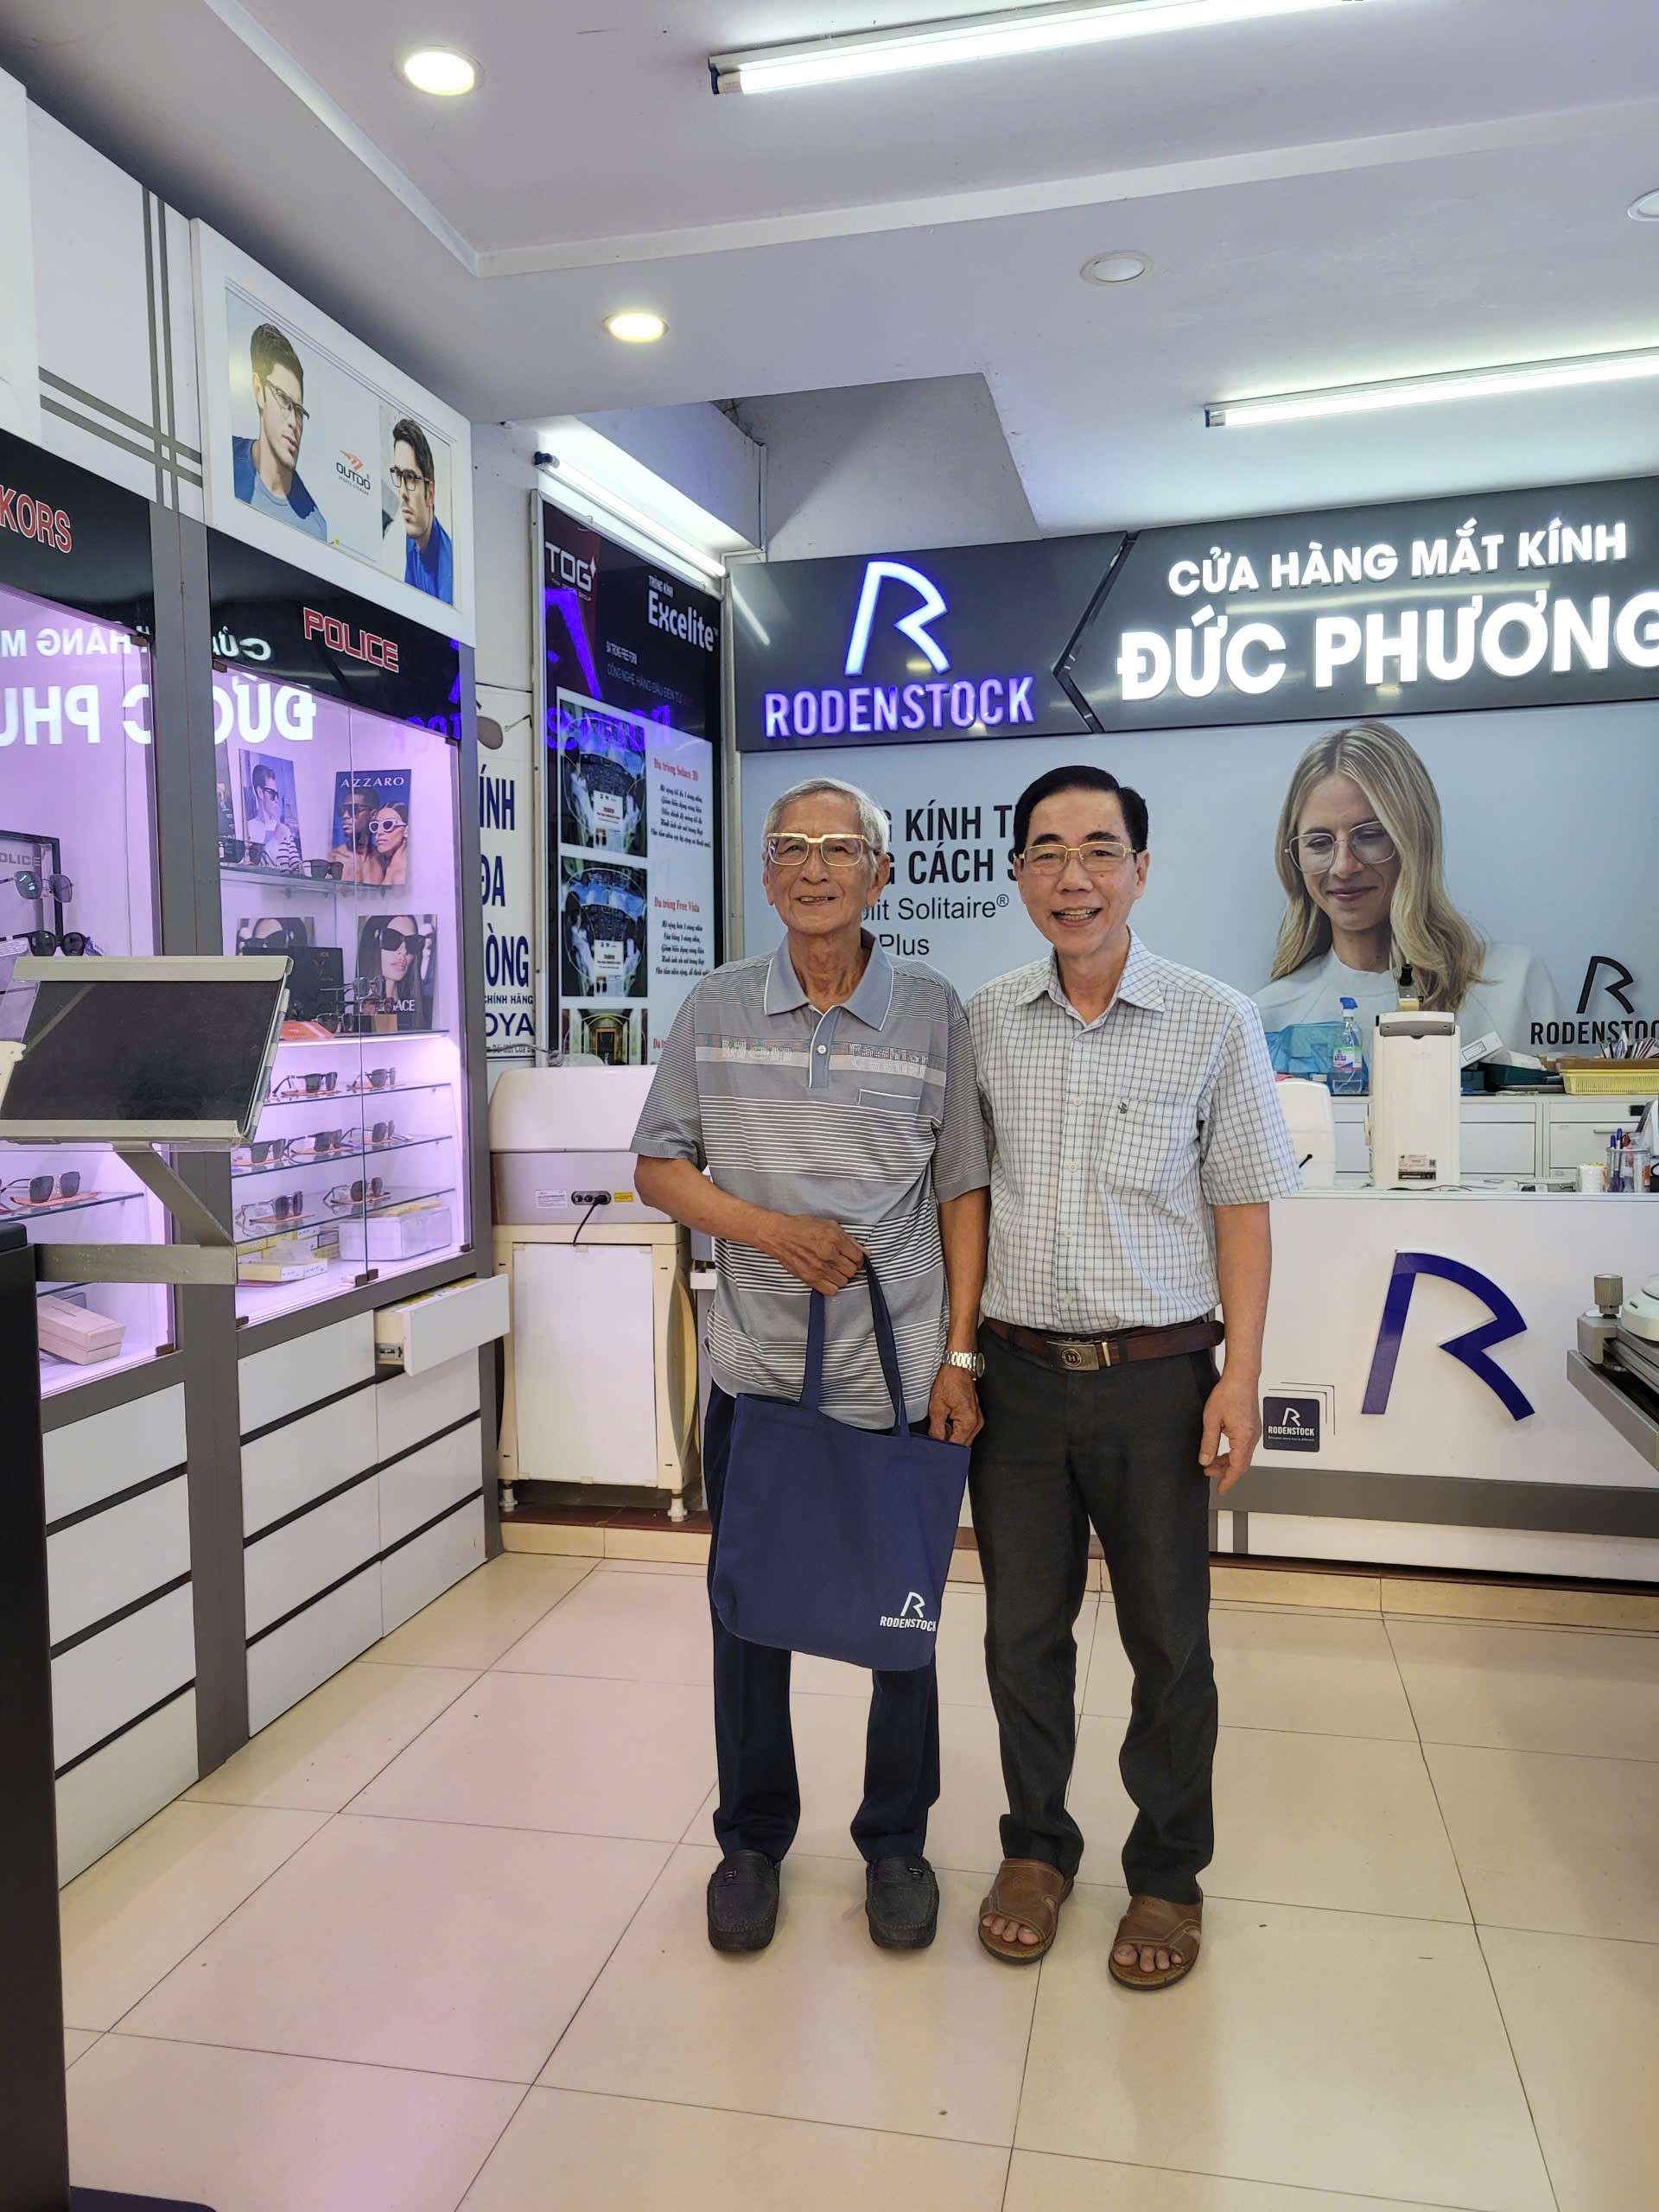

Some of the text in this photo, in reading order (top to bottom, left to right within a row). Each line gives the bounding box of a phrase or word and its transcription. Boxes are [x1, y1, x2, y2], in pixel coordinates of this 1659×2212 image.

[336, 461, 371, 491] OUTDO
[0, 484, 72, 553] KORS
[545, 541, 593, 593] TOG
[1168, 517, 1626, 595] CỬA HÀNG MẮT KÍNH
[303, 607, 399, 673] POLICE
[648, 589, 714, 652] Excelite
[1117, 589, 1659, 701] ĐỨC PHƯƠNG
[765, 677, 1034, 737] RODENSTOCK
[340, 776, 404, 788] AZZARO
[480, 764, 515, 830] ÍNH
[906, 799, 982, 842] KÍNH
[0, 852, 41, 867] OLICE
[908, 842, 993, 885] CÁCH
[486, 923, 529, 987] ÒNG
[879, 933, 930, 956] Plus
[1530, 1020, 1659, 1045] RODENSTO
[1268, 1426, 1315, 1437] RODENSTOCK
